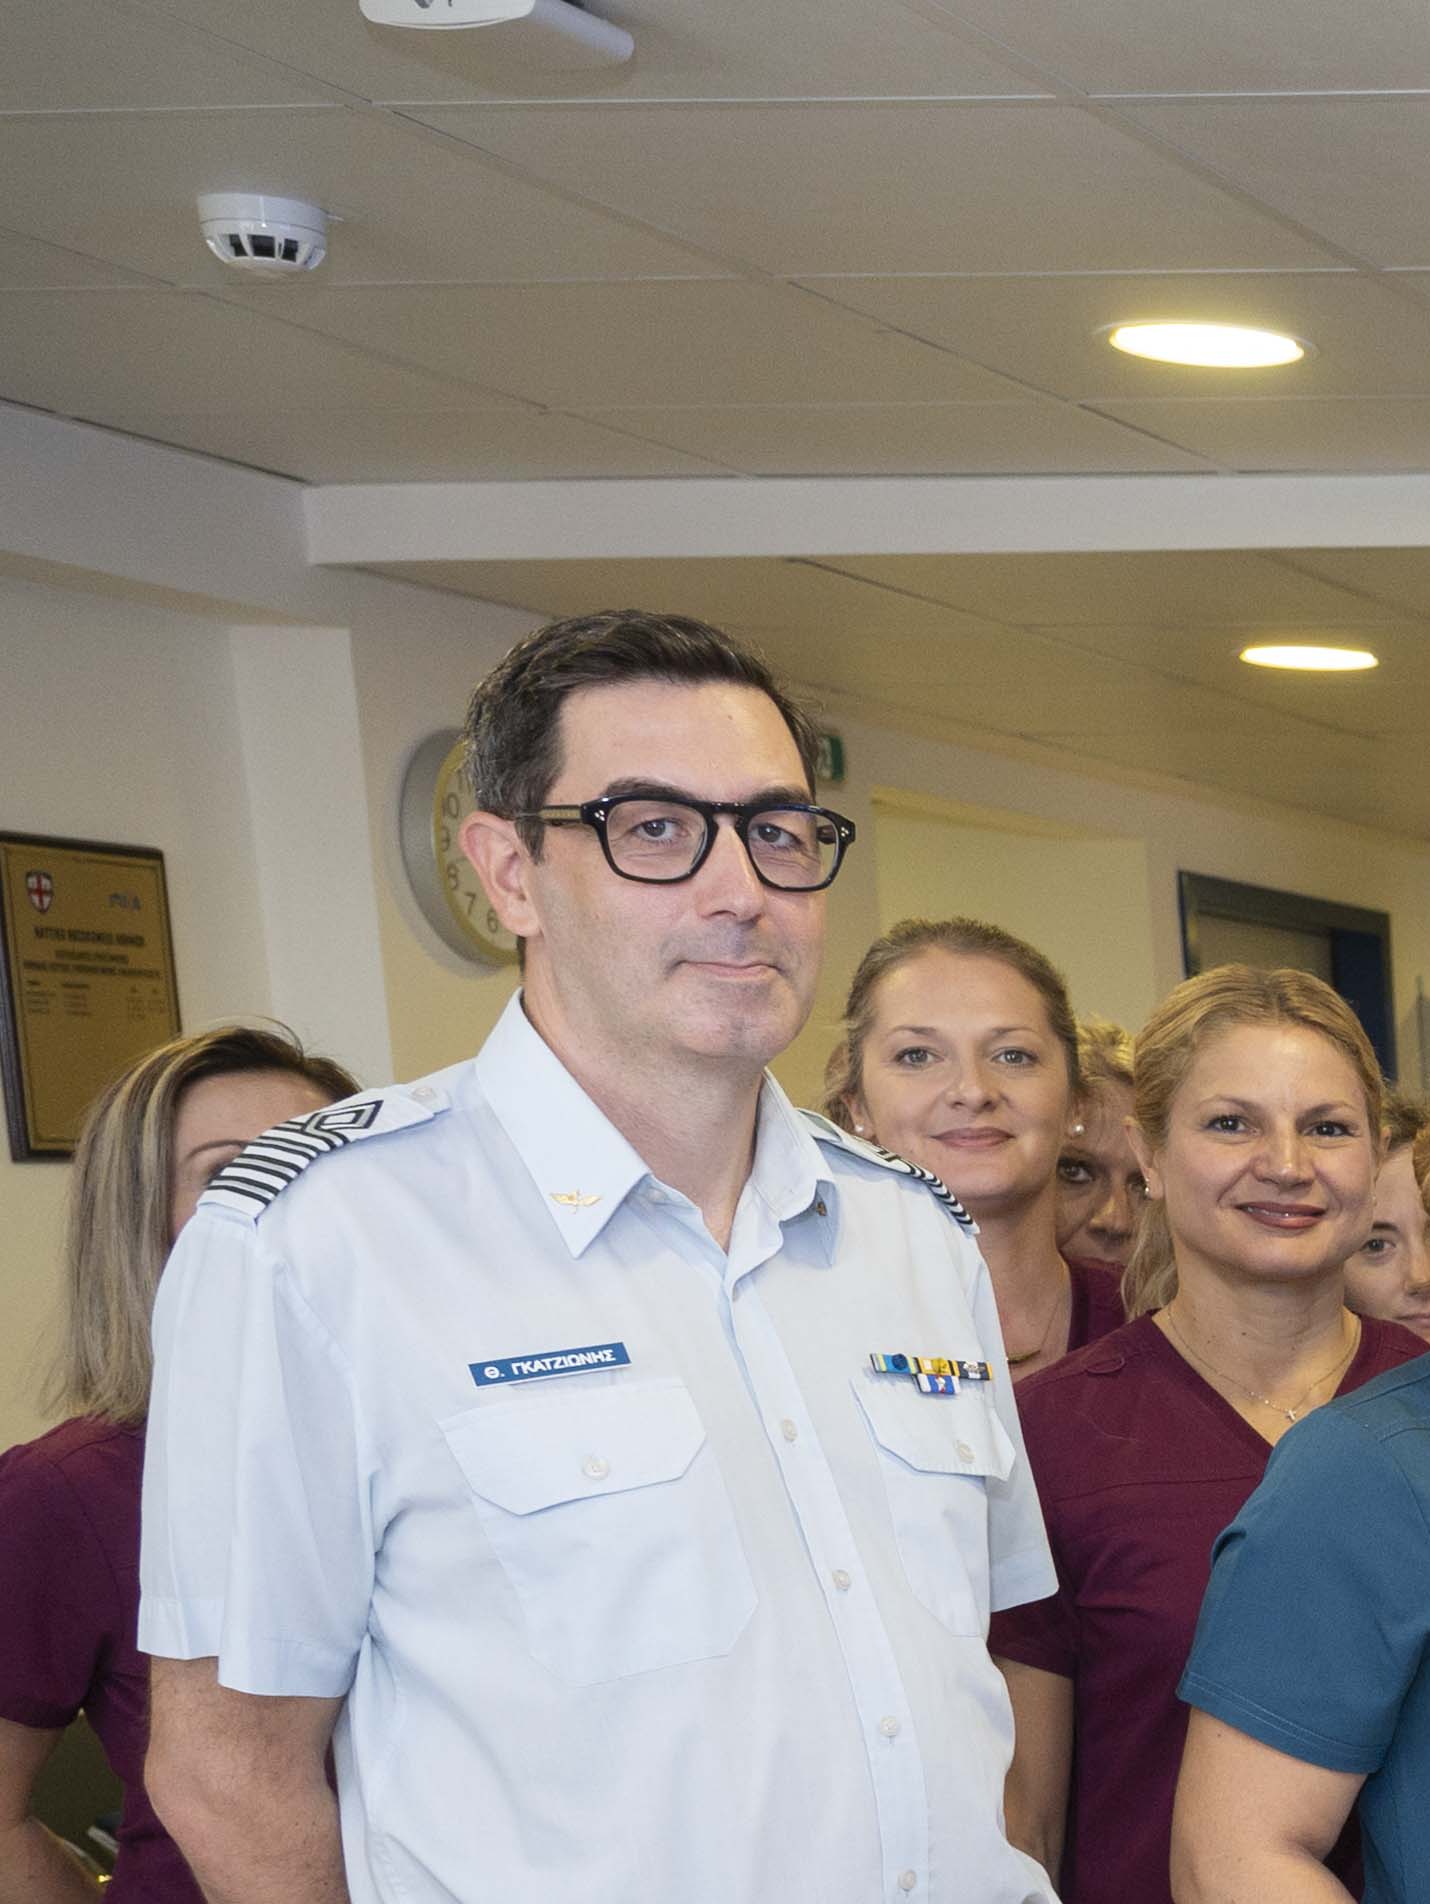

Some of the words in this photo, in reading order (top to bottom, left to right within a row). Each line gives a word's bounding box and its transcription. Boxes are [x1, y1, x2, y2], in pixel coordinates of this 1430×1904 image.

[447, 864, 459, 891] 8
[465, 892, 476, 915] 7
[486, 908, 498, 933] 6
[484, 1366, 506, 1379] Θ.
[511, 1349, 617, 1376] ΓΚΑΤΖΙΩΝΗΣ
